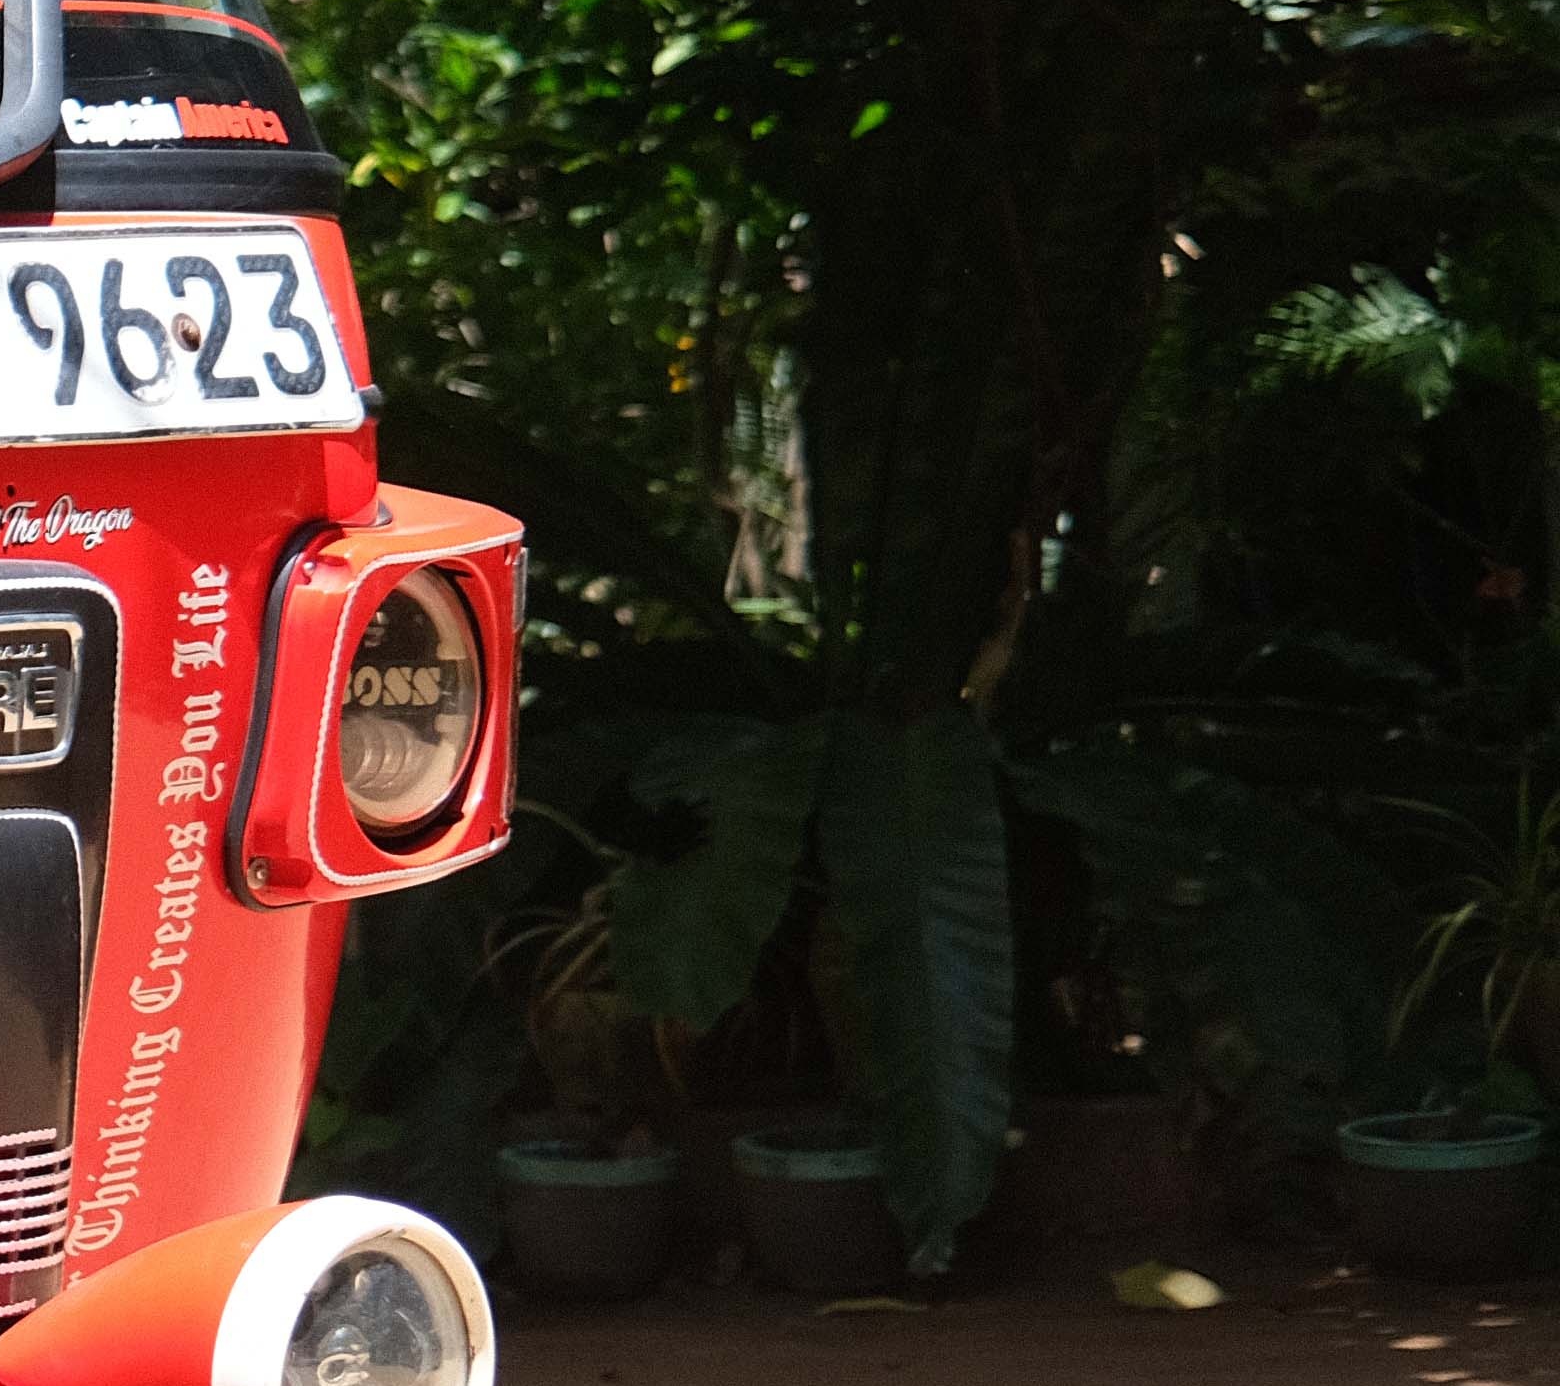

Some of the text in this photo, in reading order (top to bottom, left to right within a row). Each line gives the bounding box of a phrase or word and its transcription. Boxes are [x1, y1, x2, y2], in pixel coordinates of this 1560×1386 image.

[7, 251, 328, 408] 9623
[0, 500, 42, 547] The
[42, 493, 134, 550] Dragon
[64, 1025, 182, 1258] Thinking
[128, 819, 209, 1015] Creates
[170, 562, 230, 679] Life
